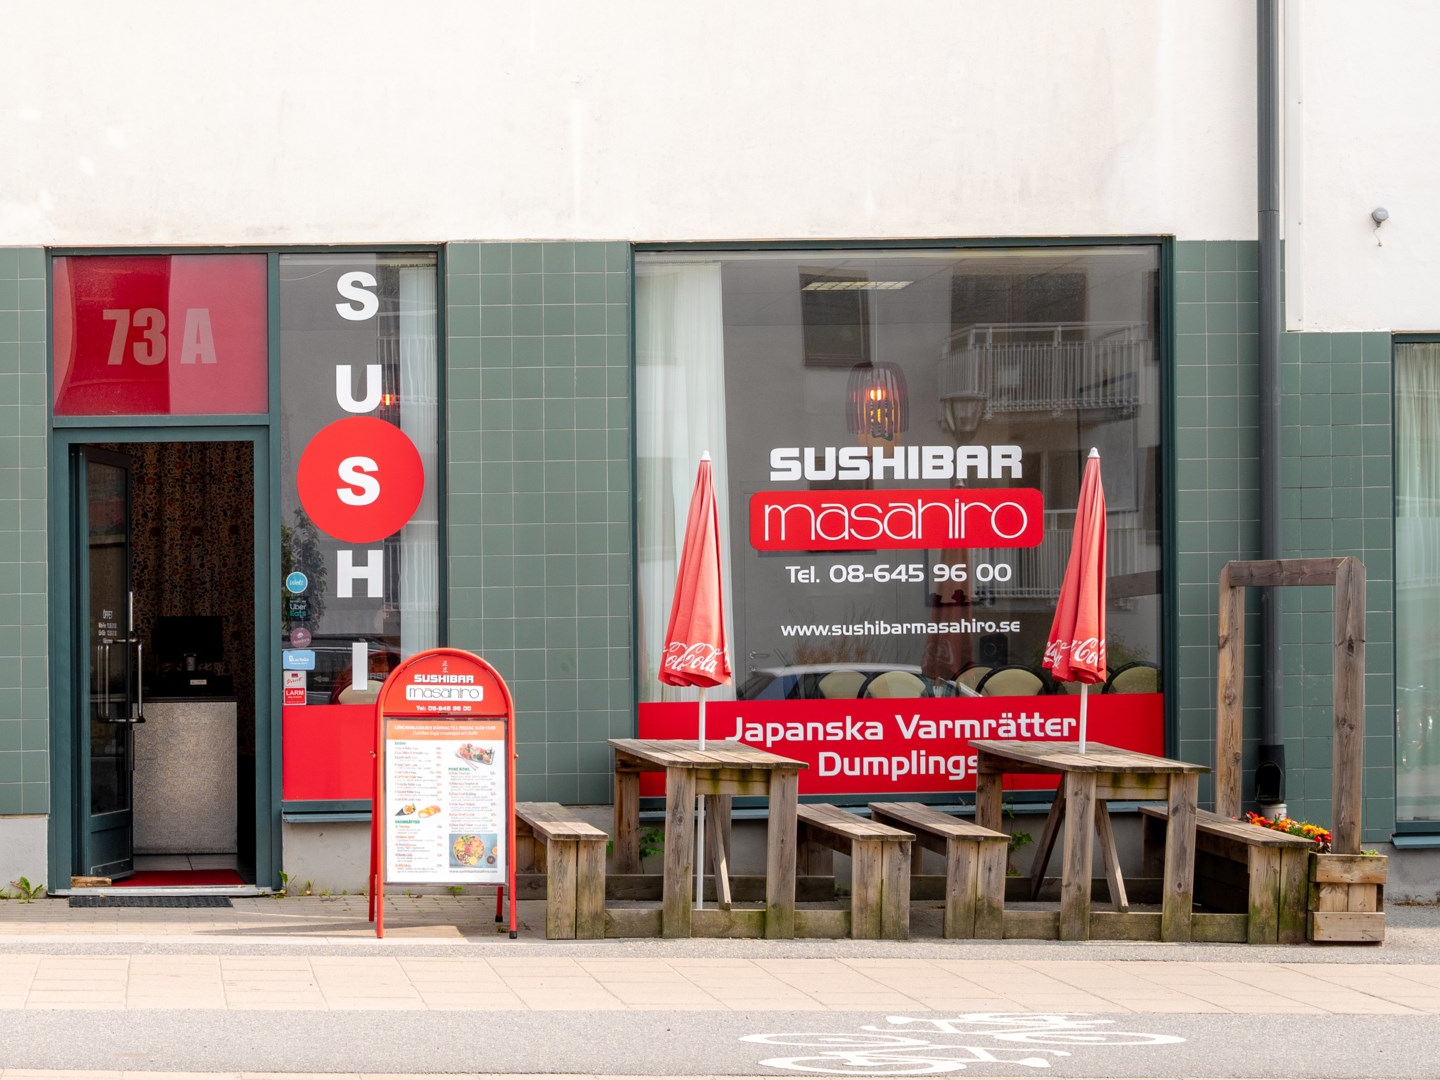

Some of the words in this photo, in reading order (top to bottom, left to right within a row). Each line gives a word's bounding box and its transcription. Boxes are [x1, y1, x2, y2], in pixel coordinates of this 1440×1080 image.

[102, 307, 167, 366] 73
[180, 308, 217, 365] A
[770, 445, 1023, 481] SUSHIBAR
[764, 498, 1028, 541] masahiro
[785, 565, 820, 583] Tel.
[829, 564, 924, 583] 08-645
[933, 564, 967, 582] 96
[975, 563, 1012, 582] 00
[780, 618, 1020, 637] www.sushibarmasahiro.se
[409, 687, 480, 699] masahiro
[413, 674, 474, 683] SUSHIBAR
[725, 716, 883, 747] Japanska
[894, 712, 1076, 740] Varmrätter
[818, 750, 978, 781] Dumplings
